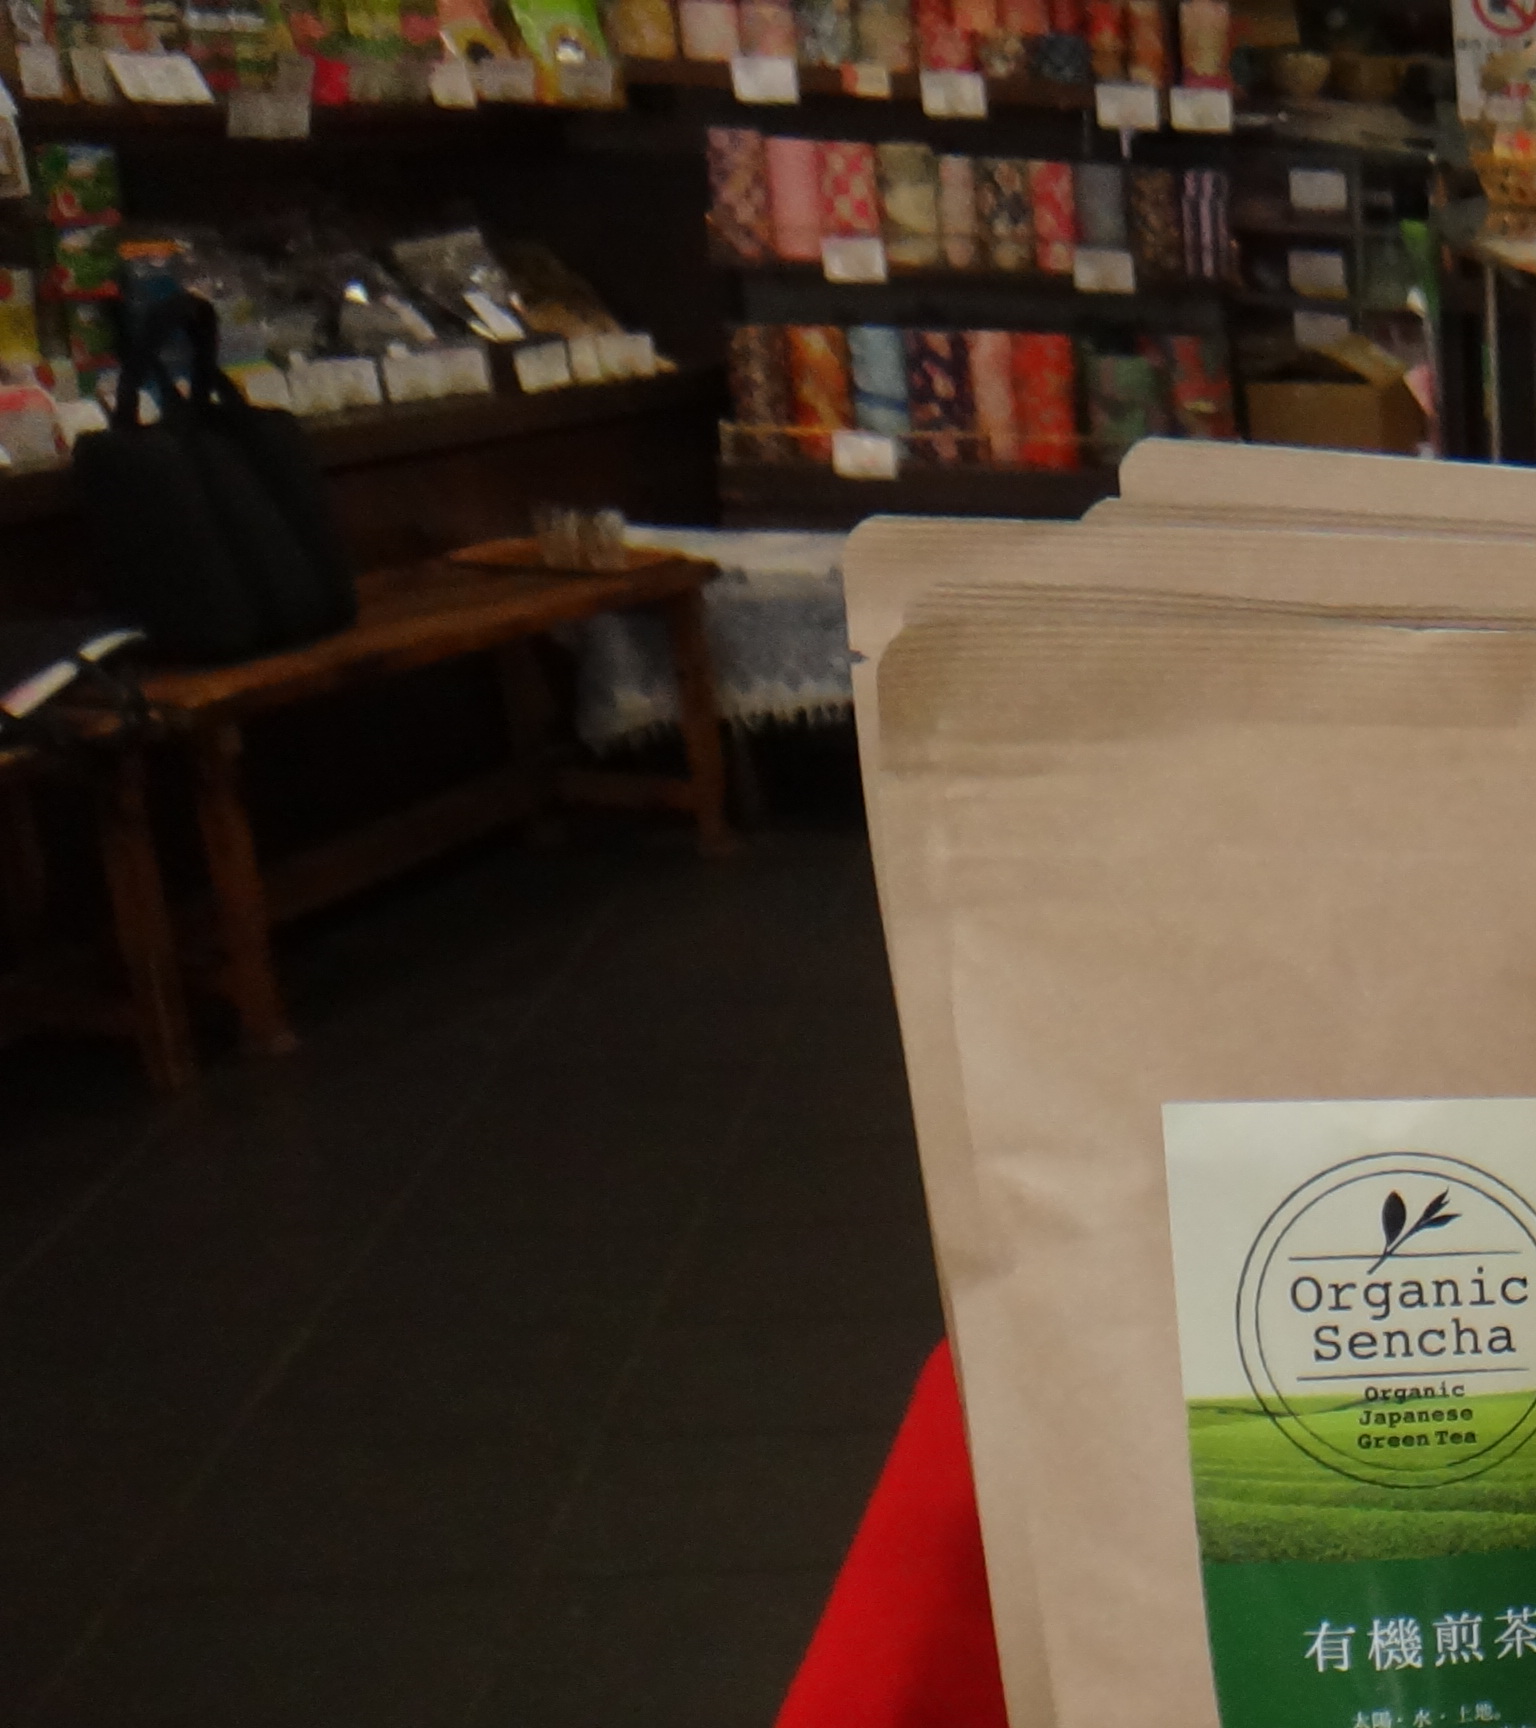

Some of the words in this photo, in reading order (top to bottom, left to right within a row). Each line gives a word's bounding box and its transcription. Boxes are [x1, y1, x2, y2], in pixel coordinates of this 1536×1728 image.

[1290, 1267, 1529, 1321] Organic
[1314, 1318, 1516, 1363] Sencha
[1364, 1381, 1465, 1402] Organic
[1358, 1407, 1473, 1428] Japanese
[1357, 1433, 1430, 1451] Green
[1434, 1429, 1477, 1447] Tea
